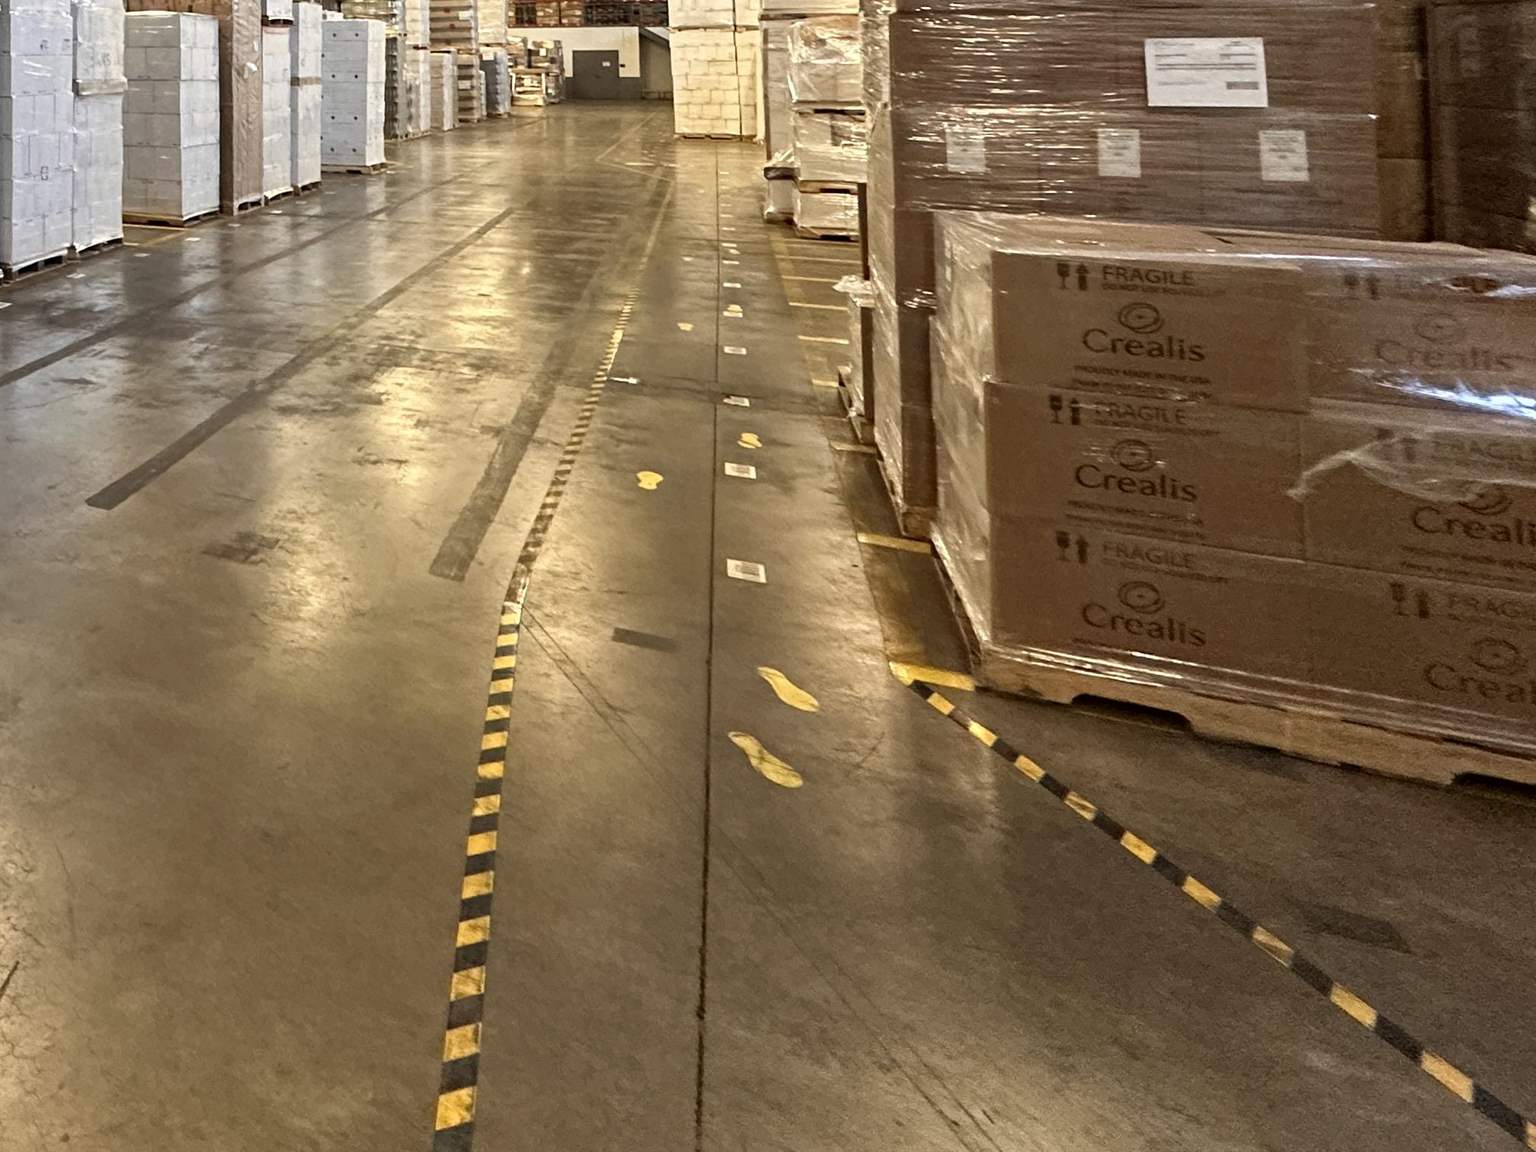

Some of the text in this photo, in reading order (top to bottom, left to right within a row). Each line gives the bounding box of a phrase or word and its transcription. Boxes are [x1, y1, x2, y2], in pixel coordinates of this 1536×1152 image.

[1102, 265, 1194, 286] FRAGILE
[1082, 328, 1206, 362] Crealis
[1094, 400, 1187, 425] FRAGILE
[1075, 464, 1197, 502] Crealis
[1102, 541, 1195, 569] FRAGILE
[1082, 603, 1206, 647] Crealis
